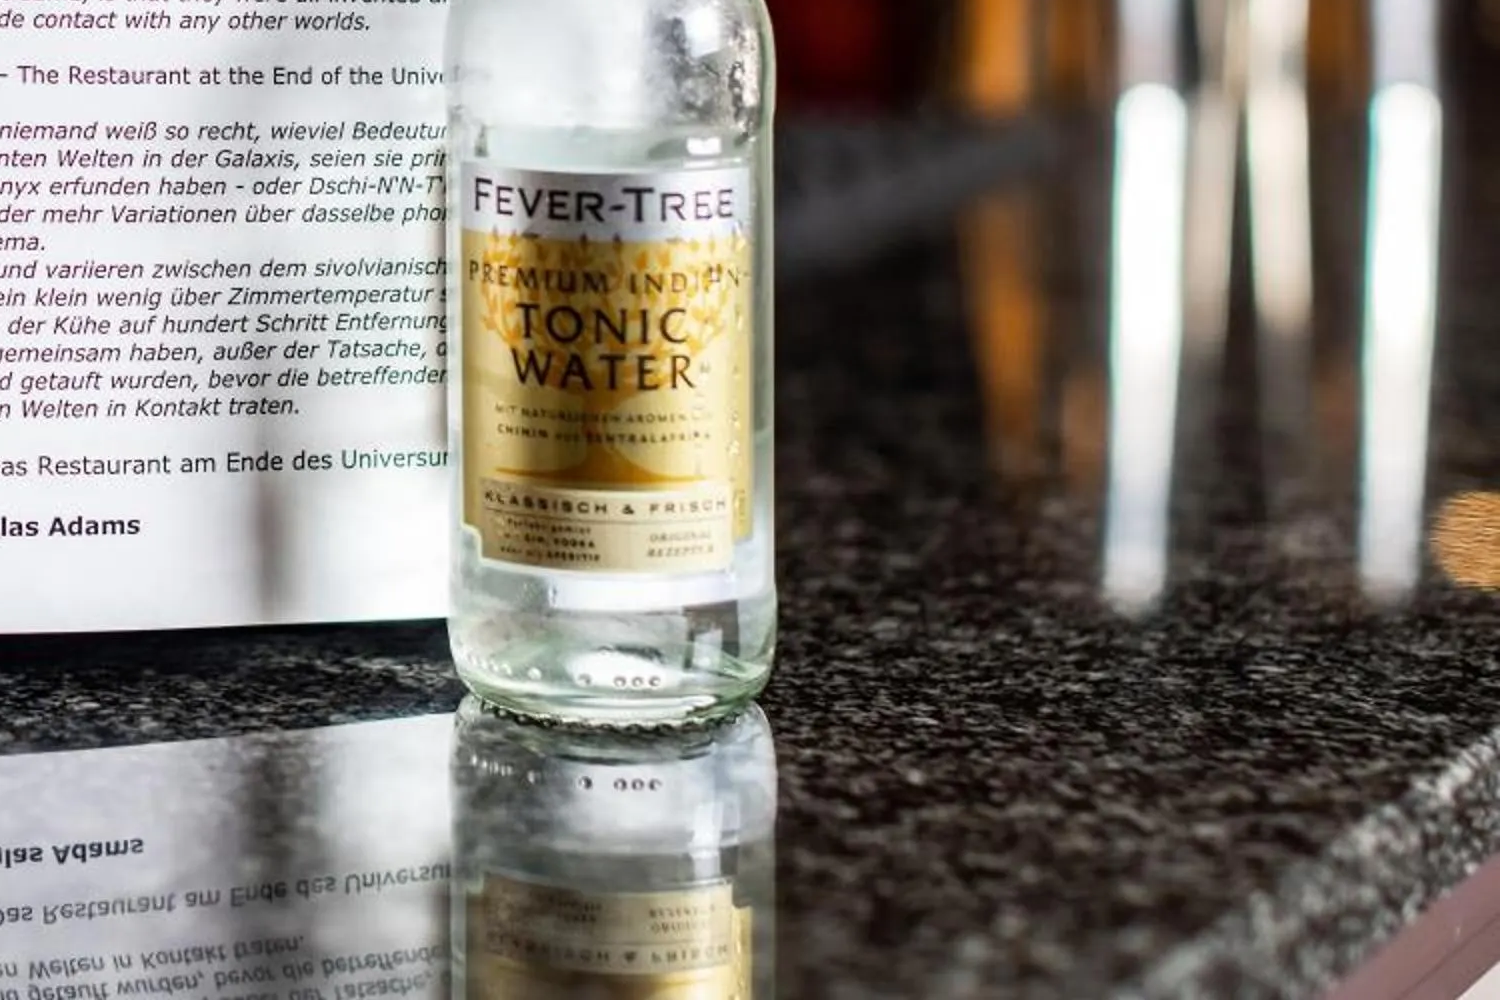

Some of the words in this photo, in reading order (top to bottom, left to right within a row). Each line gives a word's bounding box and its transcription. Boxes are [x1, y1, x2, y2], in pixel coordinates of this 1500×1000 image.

[32, 10, 119, 30] contact
[124, 9, 172, 30] with
[178, 14, 222, 35] any
[227, 10, 289, 31] other
[294, 11, 371, 32] worlds.
[15, 64, 60, 85] The
[68, 64, 192, 86] Restaurant
[198, 66, 222, 86] at
[227, 65, 265, 86] the
[272, 65, 313, 86] End
[320, 65, 343, 86] of
[348, 65, 384, 86] the
[391, 66, 444, 86] Univ
[104, 120, 158, 141] weiß
[163, 124, 190, 141] so
[197, 120, 261, 145] recht,
[270, 120, 346, 141] wieviel
[41, 203, 105, 224] mehr
[110, 204, 238, 224] Variationen
[244, 203, 297, 224] über
[301, 202, 396, 224] dasselbe
[473, 177, 735, 224] FEVER-TREE
[468, 259, 611, 295] PREMIUM
[7, 315, 47, 336] der
[53, 315, 112, 336] Kühe
[118, 314, 158, 335] auf
[161, 313, 250, 335] hundert
[255, 312, 331, 334] Schritt
[515, 303, 689, 345] TONIC
[511, 347, 696, 391] WATER
[21, 398, 100, 420] Welten
[106, 399, 127, 418] in
[134, 396, 223, 418] Kontakt
[228, 396, 300, 417] traten.
[37, 454, 172, 477] Restaurant
[179, 456, 217, 474] am
[226, 449, 284, 473] Ende
[291, 449, 333, 472] des
[484, 490, 608, 515] KLASSISCH
[621, 504, 635, 515] &
[649, 499, 726, 514] FRISCH
[47, 514, 141, 537] Adams
